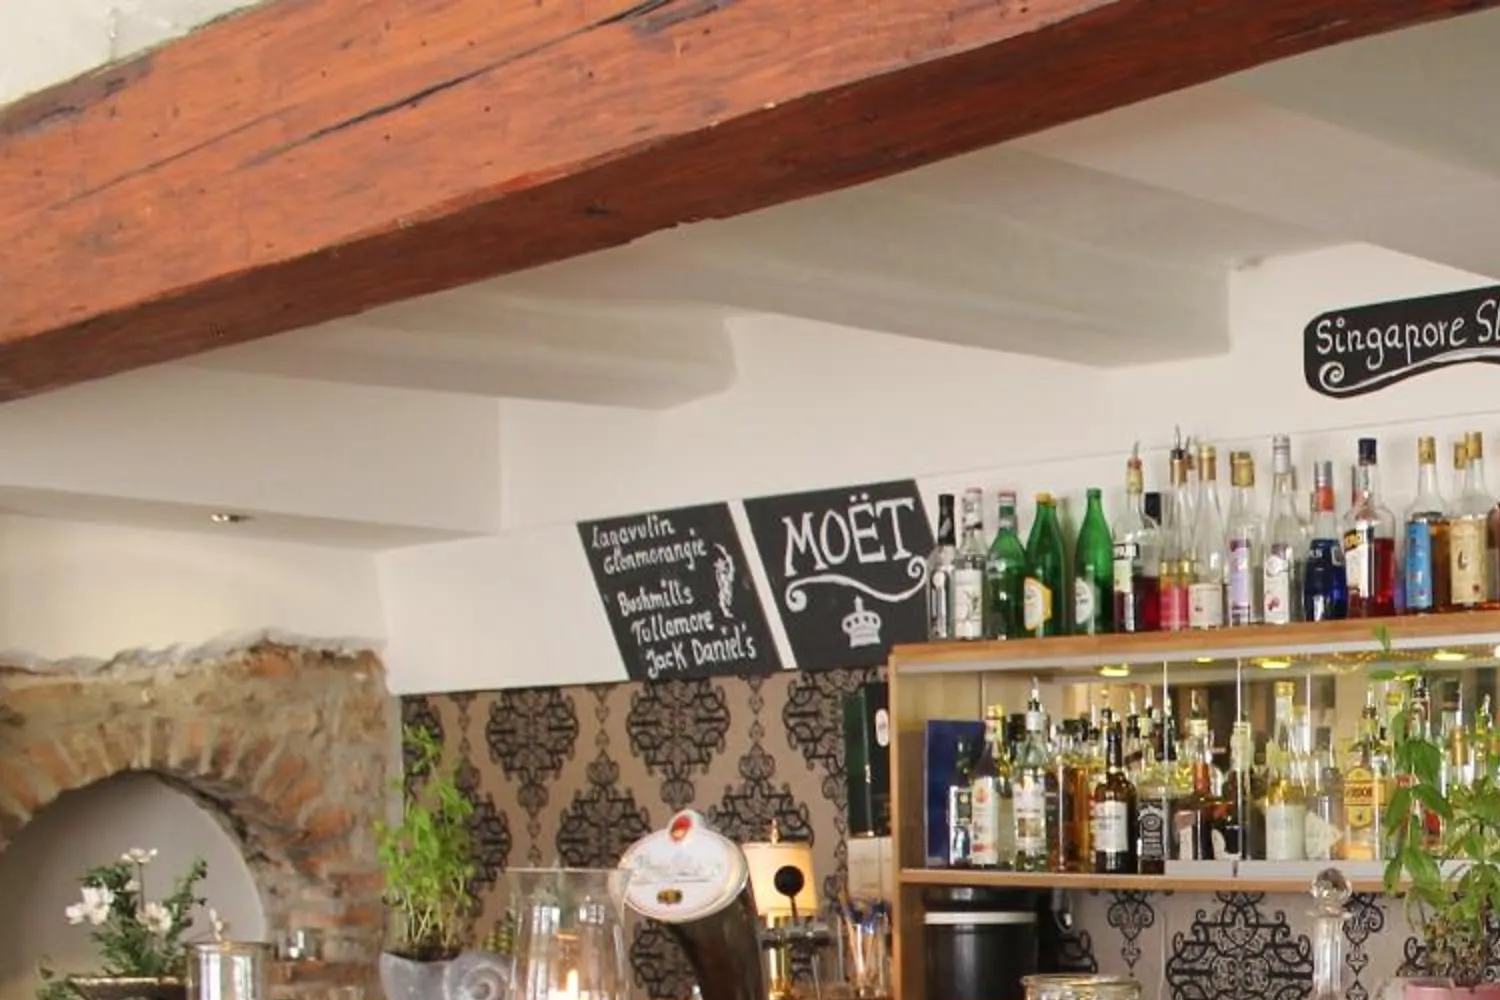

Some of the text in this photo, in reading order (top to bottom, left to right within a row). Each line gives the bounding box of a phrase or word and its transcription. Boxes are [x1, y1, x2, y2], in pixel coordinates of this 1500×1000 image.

[1315, 316, 1468, 371] Singapore
[591, 513, 676, 549] Lagavulin
[602, 527, 708, 576] Glenmorangie
[780, 492, 916, 577] MOËT
[616, 577, 695, 617] Bushmills
[690, 619, 758, 667] Daniel's
